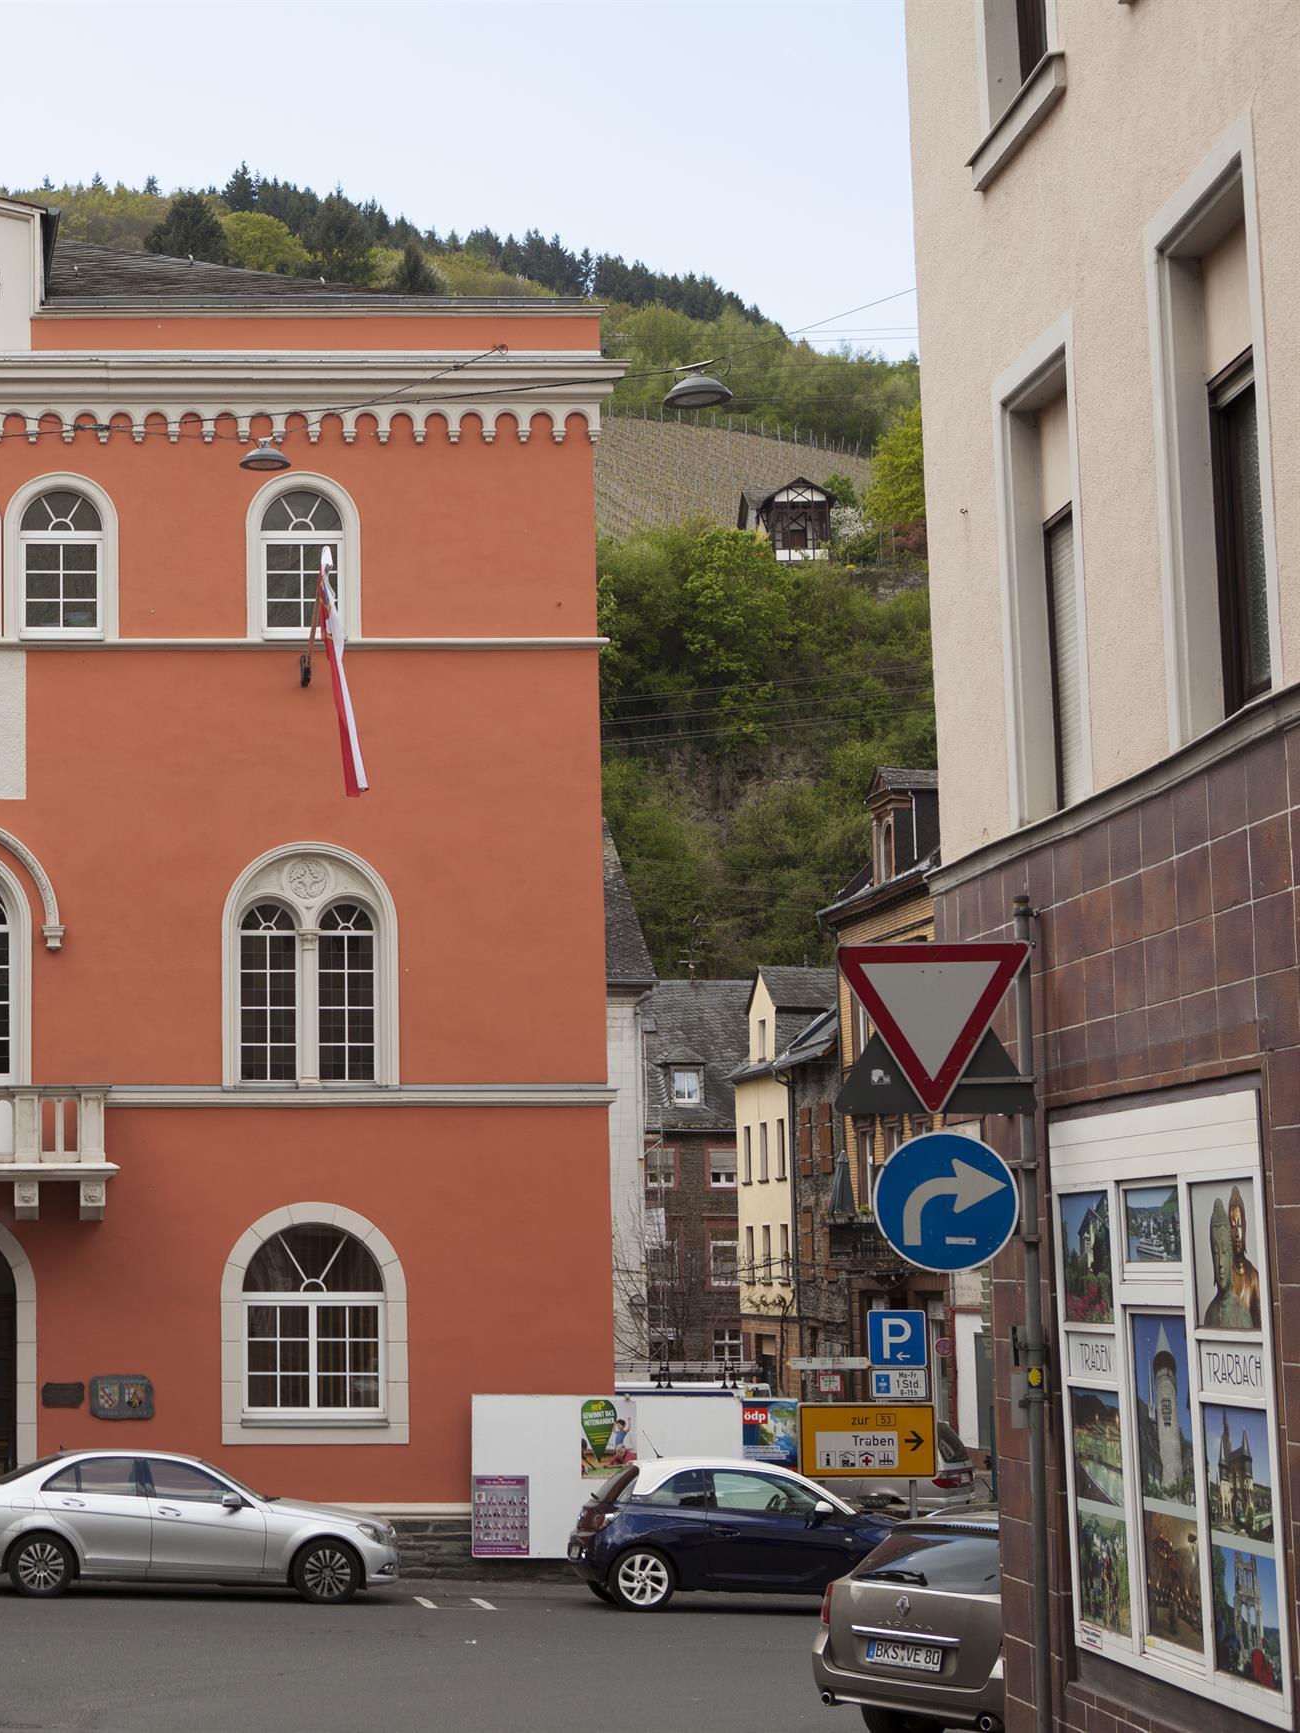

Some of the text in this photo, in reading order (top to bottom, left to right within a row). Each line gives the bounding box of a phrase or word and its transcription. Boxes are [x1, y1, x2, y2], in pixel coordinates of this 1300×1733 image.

[882, 1318, 912, 1359] P
[1079, 1343, 1112, 1373] TRABEN
[898, 1371, 917, 1379] Mo-Fr
[1206, 1352, 1263, 1387] TRARBACH
[902, 1380, 922, 1389] Std.
[605, 1409, 615, 1417] DAS
[744, 1411, 767, 1423] ödp
[851, 1415, 892, 1426] zur 53
[852, 1435, 895, 1447] Traben
[875, 1642, 900, 1660] BKS
[906, 1647, 922, 1663] VE
[924, 1649, 941, 1666] 80
